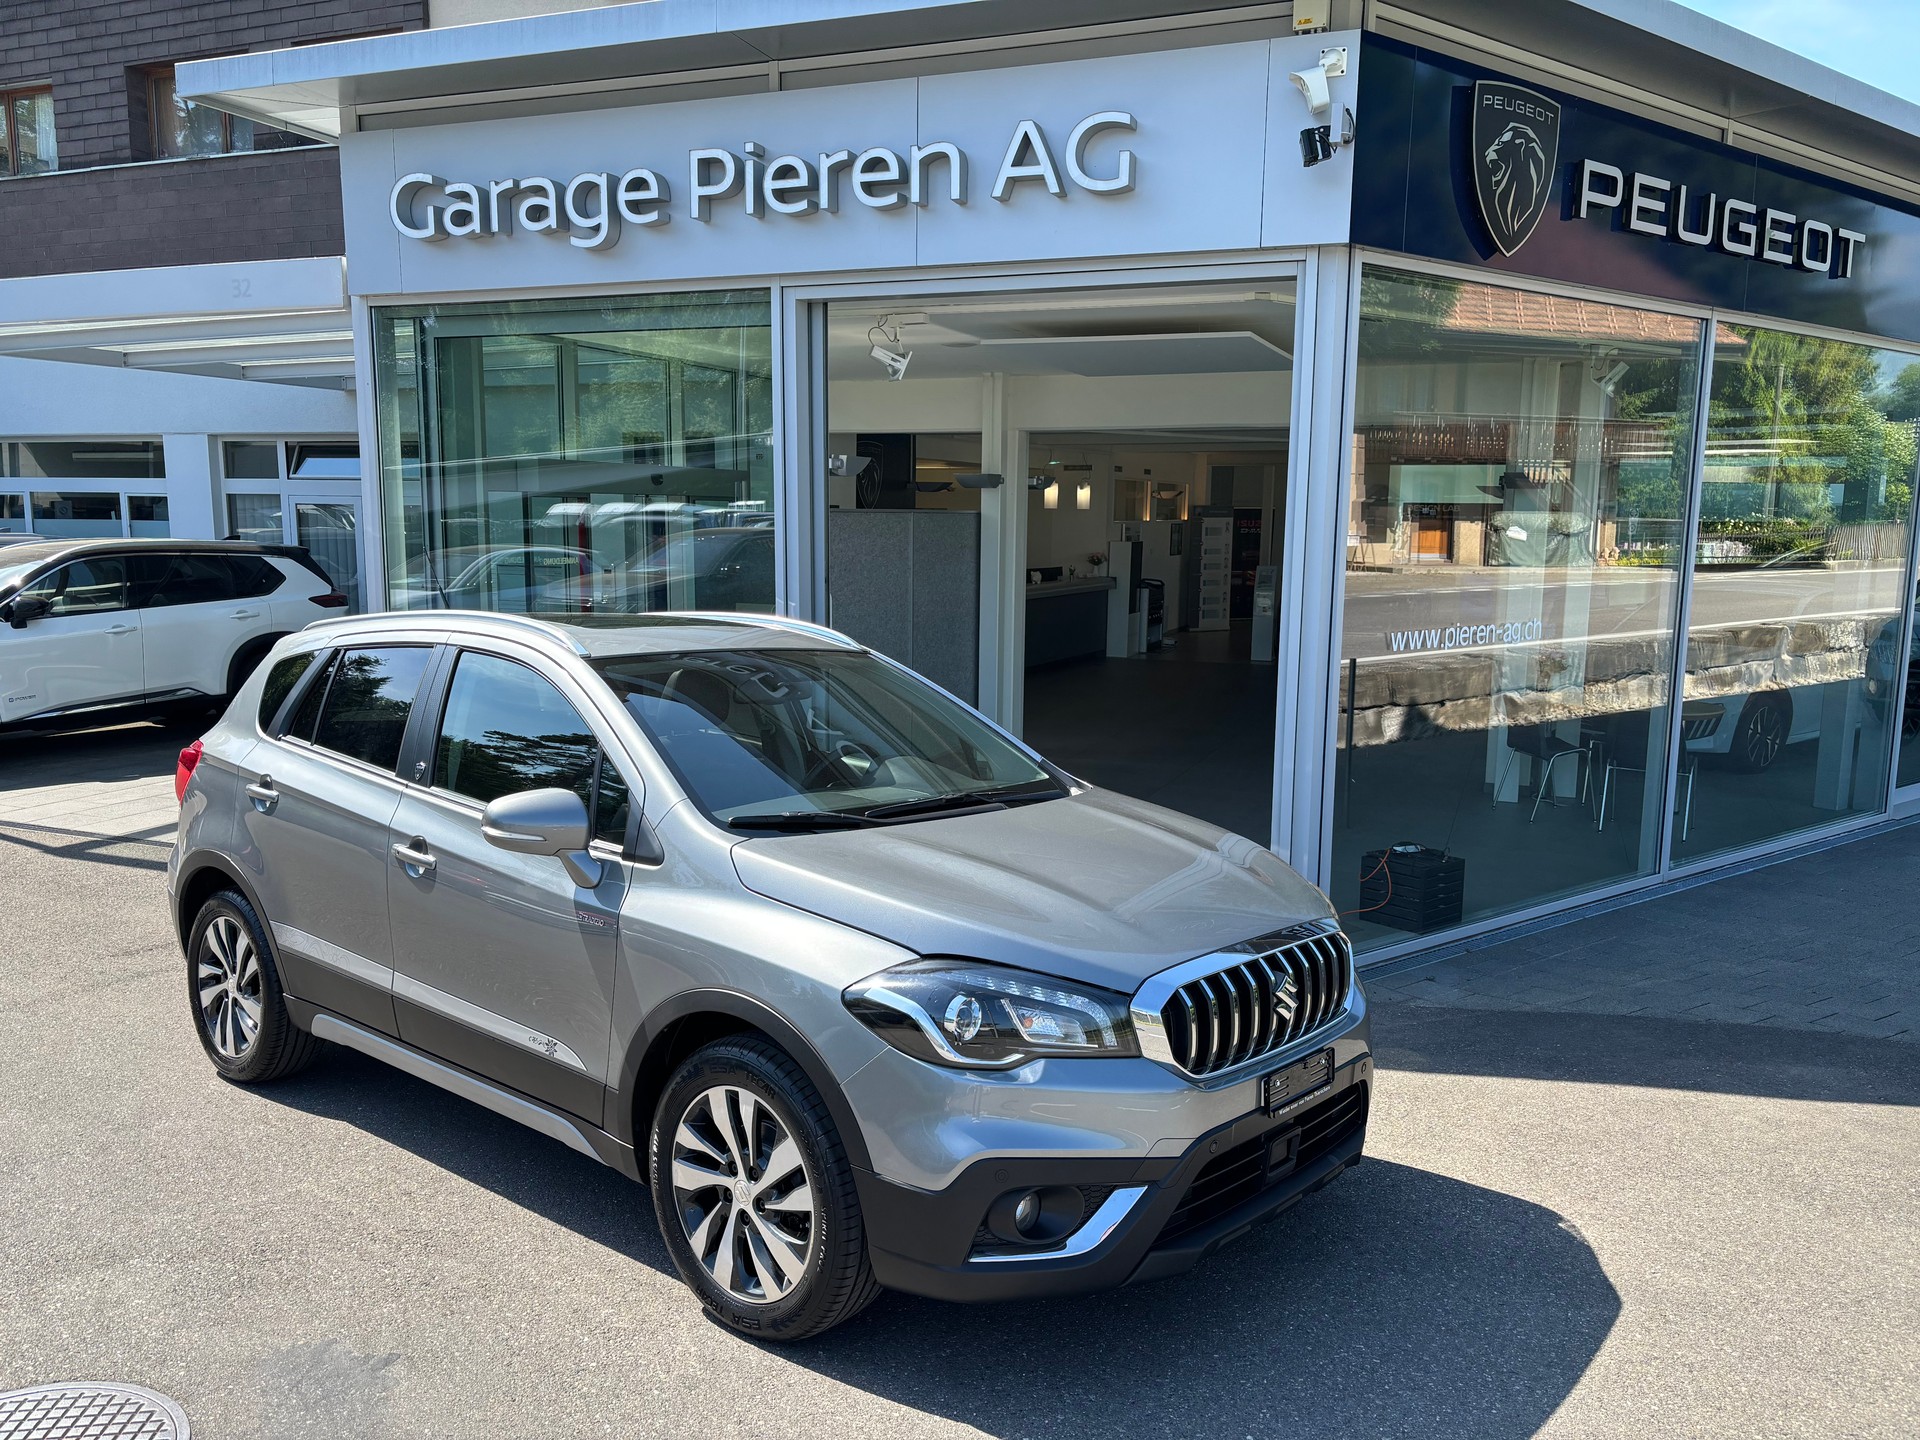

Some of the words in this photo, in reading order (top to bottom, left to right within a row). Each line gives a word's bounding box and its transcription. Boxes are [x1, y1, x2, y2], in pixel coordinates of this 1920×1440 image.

[1482, 94, 1554, 125] PEUGEOT
[389, 167, 671, 250] Garage
[690, 140, 968, 222] Pieren
[991, 110, 1138, 201] AG
[1578, 158, 1866, 278] PEUGEOT
[231, 279, 252, 298] 32
[1408, 504, 1440, 512] DESIGN
[1442, 504, 1461, 512] LAB
[1391, 617, 1542, 652] www.pieren-ag.ch
